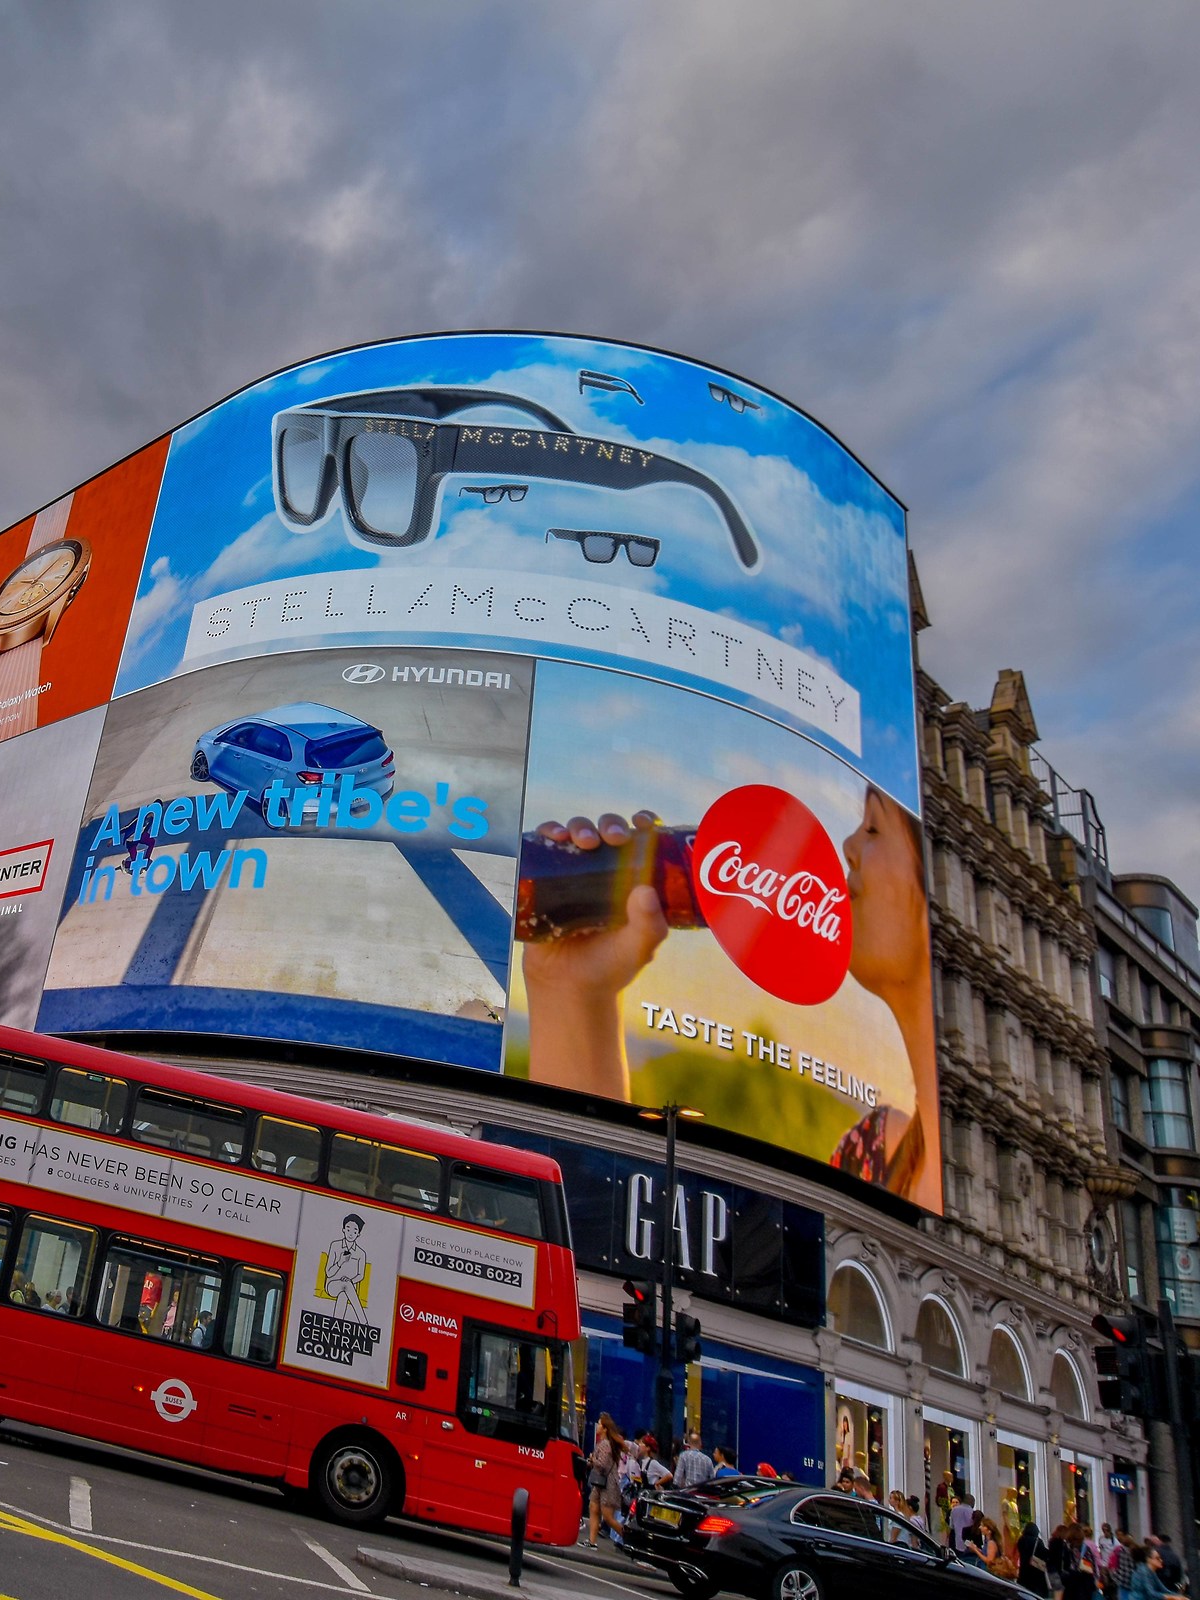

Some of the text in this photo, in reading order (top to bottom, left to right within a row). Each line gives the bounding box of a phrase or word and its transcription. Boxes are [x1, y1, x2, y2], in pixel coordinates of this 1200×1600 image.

[24, 681, 53, 700] Watch
[391, 666, 511, 690] HYUNDAI
[4, 711, 22, 724] now
[89, 772, 489, 852] A new tribe's
[77, 847, 268, 907] in town
[699, 840, 847, 943] Coca-Cola
[641, 1001, 877, 1108] TASTE THE FEELING
[23, 1139, 61, 1161] HAS
[66, 1150, 129, 1177] NEVER
[134, 1166, 183, 1190] BEEN
[189, 1179, 214, 1197] SO
[221, 1187, 282, 1215] CLEAR
[47, 1167, 54, 1175] 8
[56, 1169, 110, 1189] COLLEGES
[112, 1183, 120, 1191] &
[122, 1185, 193, 1209] UNIVERSITIES
[217, 1207, 222, 1216] 1
[225, 1209, 251, 1223] CALL
[625, 1173, 727, 1278] GAP
[415, 1234, 524, 1268] SECURE YOUR PLACE NOW
[416, 1250, 521, 1286] 020 3005 6022
[302, 1312, 379, 1341] CLEARING
[416, 1310, 458, 1330] ARRIVA
[438, 1329, 458, 1339] company
[299, 1341, 351, 1363] .CO.UK
[301, 1326, 370, 1354] CENTRAL
[165, 1395, 183, 1406] BUSES
[395, 1411, 407, 1421] AR
[517, 1445, 545, 1460] HV 250
